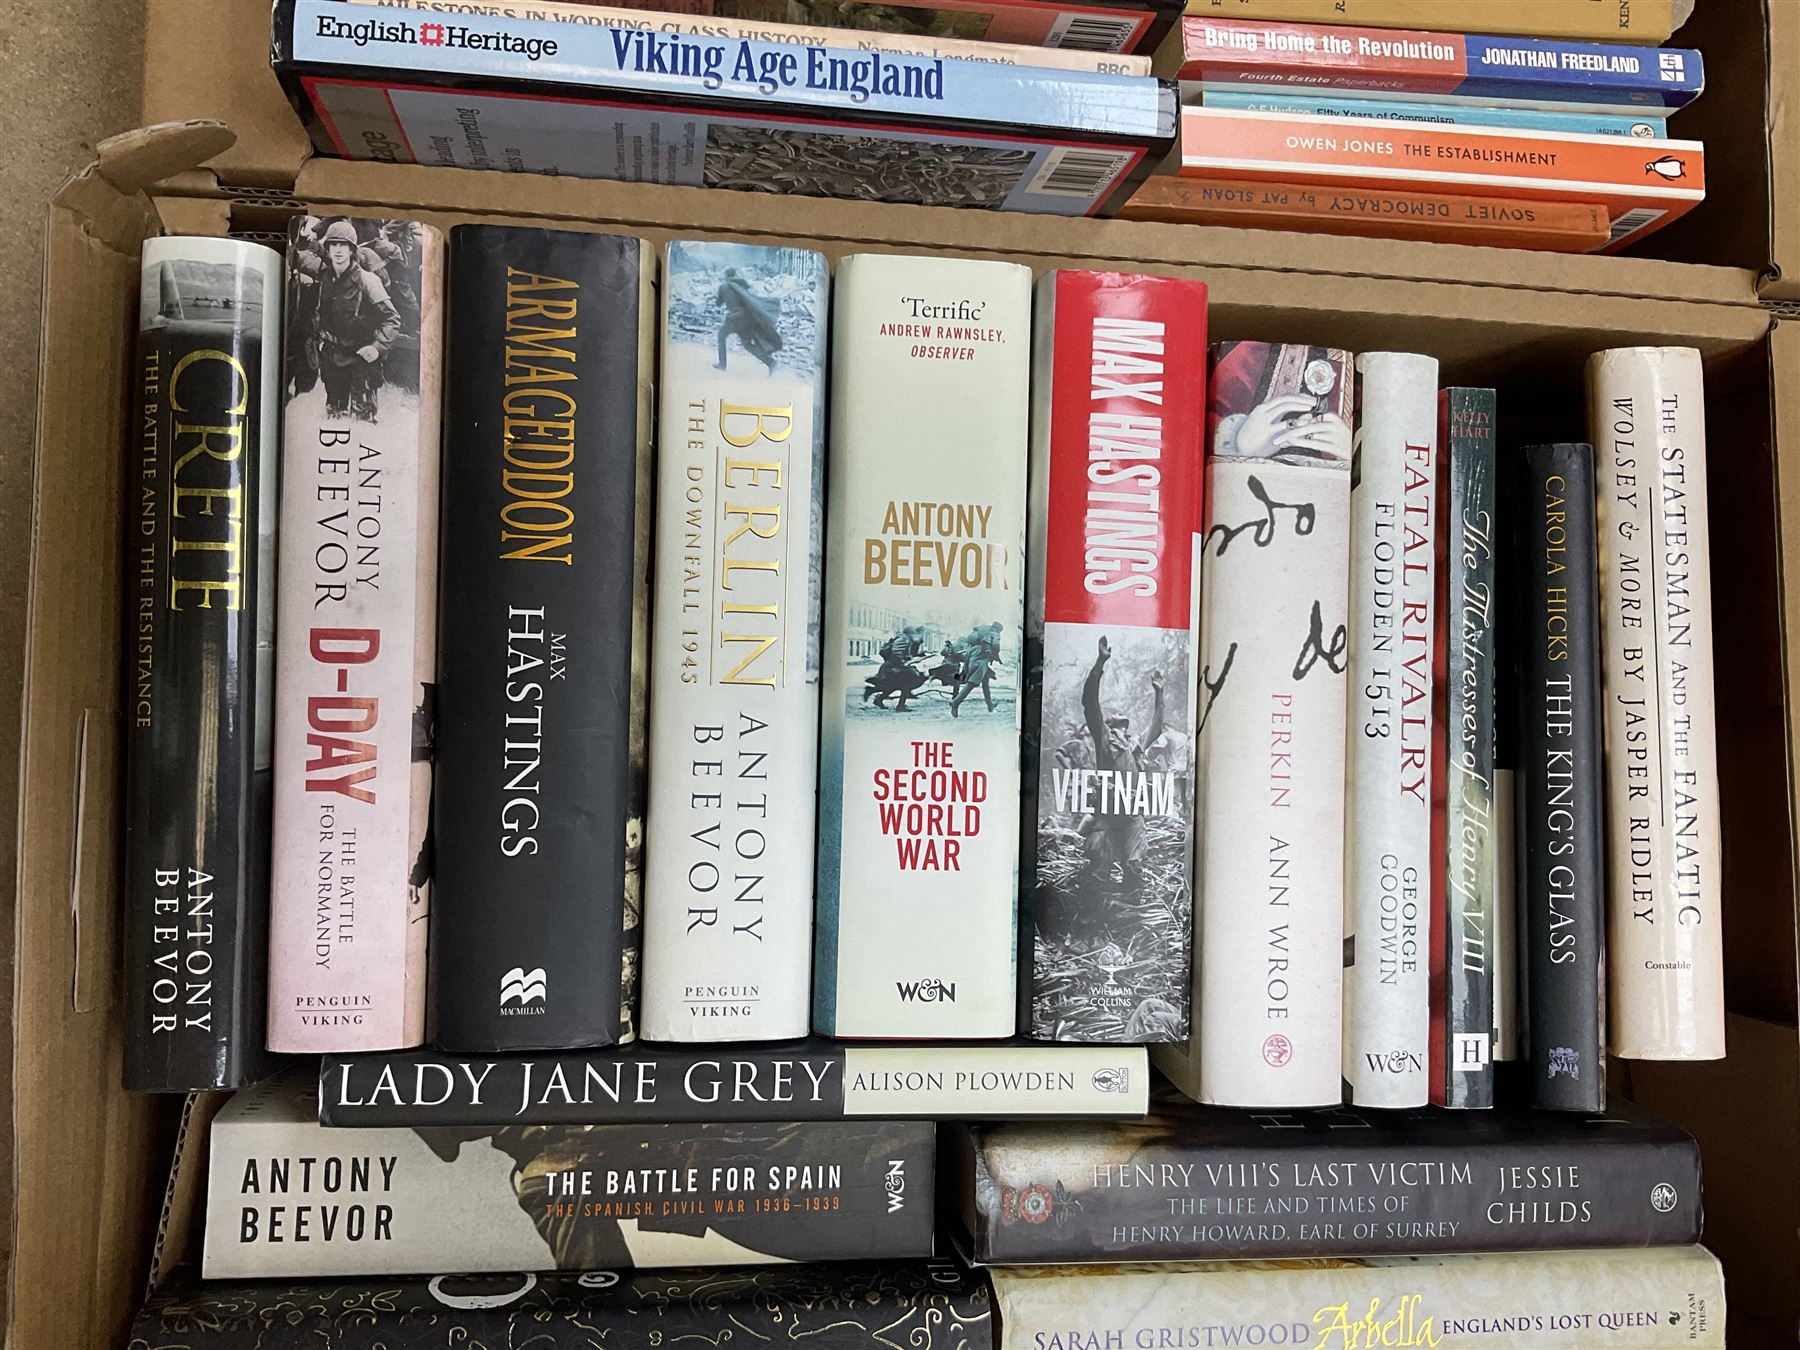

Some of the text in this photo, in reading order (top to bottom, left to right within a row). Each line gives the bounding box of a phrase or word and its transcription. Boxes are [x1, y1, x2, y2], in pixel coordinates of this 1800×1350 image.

[316, 15, 558, 61] English Heritage
[1204, 27, 1455, 61] Bring Home the Revolution
[609, 28, 944, 104] Viking Age England
[1482, 47, 1640, 74] JONATHAN FREEDLAND
[1239, 72, 1405, 89] Fourth Estate Paperbacks
[1286, 135, 1557, 166] OWEN JONES THE ESTABLISHMENT
[1202, 187, 1536, 222] SOVIET DEMOCRACY by PAT SLOAN
[901, 296, 986, 321] 'Terrific'
[880, 323, 1006, 343] ANDREW RAWNSLEY,
[911, 345, 976, 361] OBSERVER
[499, 265, 581, 566] ARMAGEDDON
[1083, 317, 1165, 598] MAX HASTINGS
[168, 348, 249, 612] CRETE
[314, 428, 351, 610] BEEVOR
[355, 444, 382, 591] ANTONY
[881, 501, 993, 539] ANTONY
[137, 350, 159, 728] THE BATTLE AND THE RESISTANCE
[680, 399, 706, 685] THE DOWNFALL 1945
[718, 398, 794, 691] BERLIN
[864, 538, 1009, 591] BEEVOR
[1545, 475, 1568, 661] CAROLA HICKS
[1364, 501, 1396, 739] FLODDEN 1513
[1400, 439, 1431, 807] FATAL RIVALRY
[549, 632, 568, 681] MAX
[1613, 396, 1654, 925] WOLSEY & MORE BY JASPER RIDLEY
[1661, 393, 1702, 926] THE STATESMAN AND THE FANATIC
[305, 627, 381, 806] D-DAY
[500, 604, 546, 857] HASTINGS
[911, 741, 954, 768] THE
[1269, 693, 1293, 809] PERKIN
[1448, 506, 1491, 976] The Mistresses of Henry VIII
[873, 769, 988, 803] SECOND
[1052, 768, 1174, 816] VIETNAM
[686, 723, 724, 935] BEEVOR
[732, 711, 769, 943] ANTONY
[879, 803, 982, 837] WORLD
[1545, 673, 1576, 964] THE KING'S GLASS
[896, 838, 961, 871] WAR
[315, 804, 335, 969] FOR NORMANDY
[338, 828, 357, 943] THE BATTLE
[1266, 835, 1291, 1020] ANN WROE
[1379, 853, 1399, 986] GOODWIN
[1401, 866, 1418, 973] GEORGE
[152, 867, 180, 1034] BEEVOR
[185, 867, 214, 1033] ANTONY
[1645, 960, 1692, 970] Constable
[295, 996, 372, 1007] PENGUIN
[684, 985, 761, 997] PENGUIN
[896, 978, 956, 1003] W&N
[1089, 986, 1132, 996] WILLIAM
[1089, 997, 1132, 1007] COLLINS
[301, 1015, 364, 1026] VIKING
[500, 1006, 546, 1016] MACMILLAN
[690, 1005, 752, 1017] VIKING
[1365, 1050, 1423, 1074] W&N
[1461, 1039, 1481, 1064] H
[337, 1060, 835, 1116] LADY JANE GREY
[852, 1071, 1075, 1092] ALISON PLOWDEN
[240, 1156, 398, 1194] ANTONY
[546, 1164, 842, 1196] THE BATTLE FOR SPAIN
[884, 1159, 905, 1214] W&N
[1092, 1161, 1474, 1188] HENRY VIII'S LAST VICTIM
[1499, 1165, 1582, 1194] JESSIE
[240, 1204, 394, 1243] BEEVOR
[546, 1203, 573, 1218] THE
[584, 1202, 654, 1217] SPANISH
[662, 1201, 704, 1217] CIVIL
[714, 1199, 746, 1214] WAR
[1167, 1195, 1410, 1215] THE LIFE AND TIMES OF
[1486, 1200, 1593, 1225] CHILDS
[1112, 1226, 1185, 1243] HENRY
[1299, 1223, 1346, 1240] EARL
[1353, 1222, 1380, 1239] OF
[1386, 1221, 1461, 1239] SURREY
[1312, 1294, 1445, 1350] Arbella
[1443, 1310, 1659, 1336] ENGLAND'S LOST QUEEN
[1687, 1293, 1697, 1339] BANTAM
[1699, 1299, 1707, 1332] PRESS
[1033, 1322, 1311, 1350] SARAH GRISTWOOD
